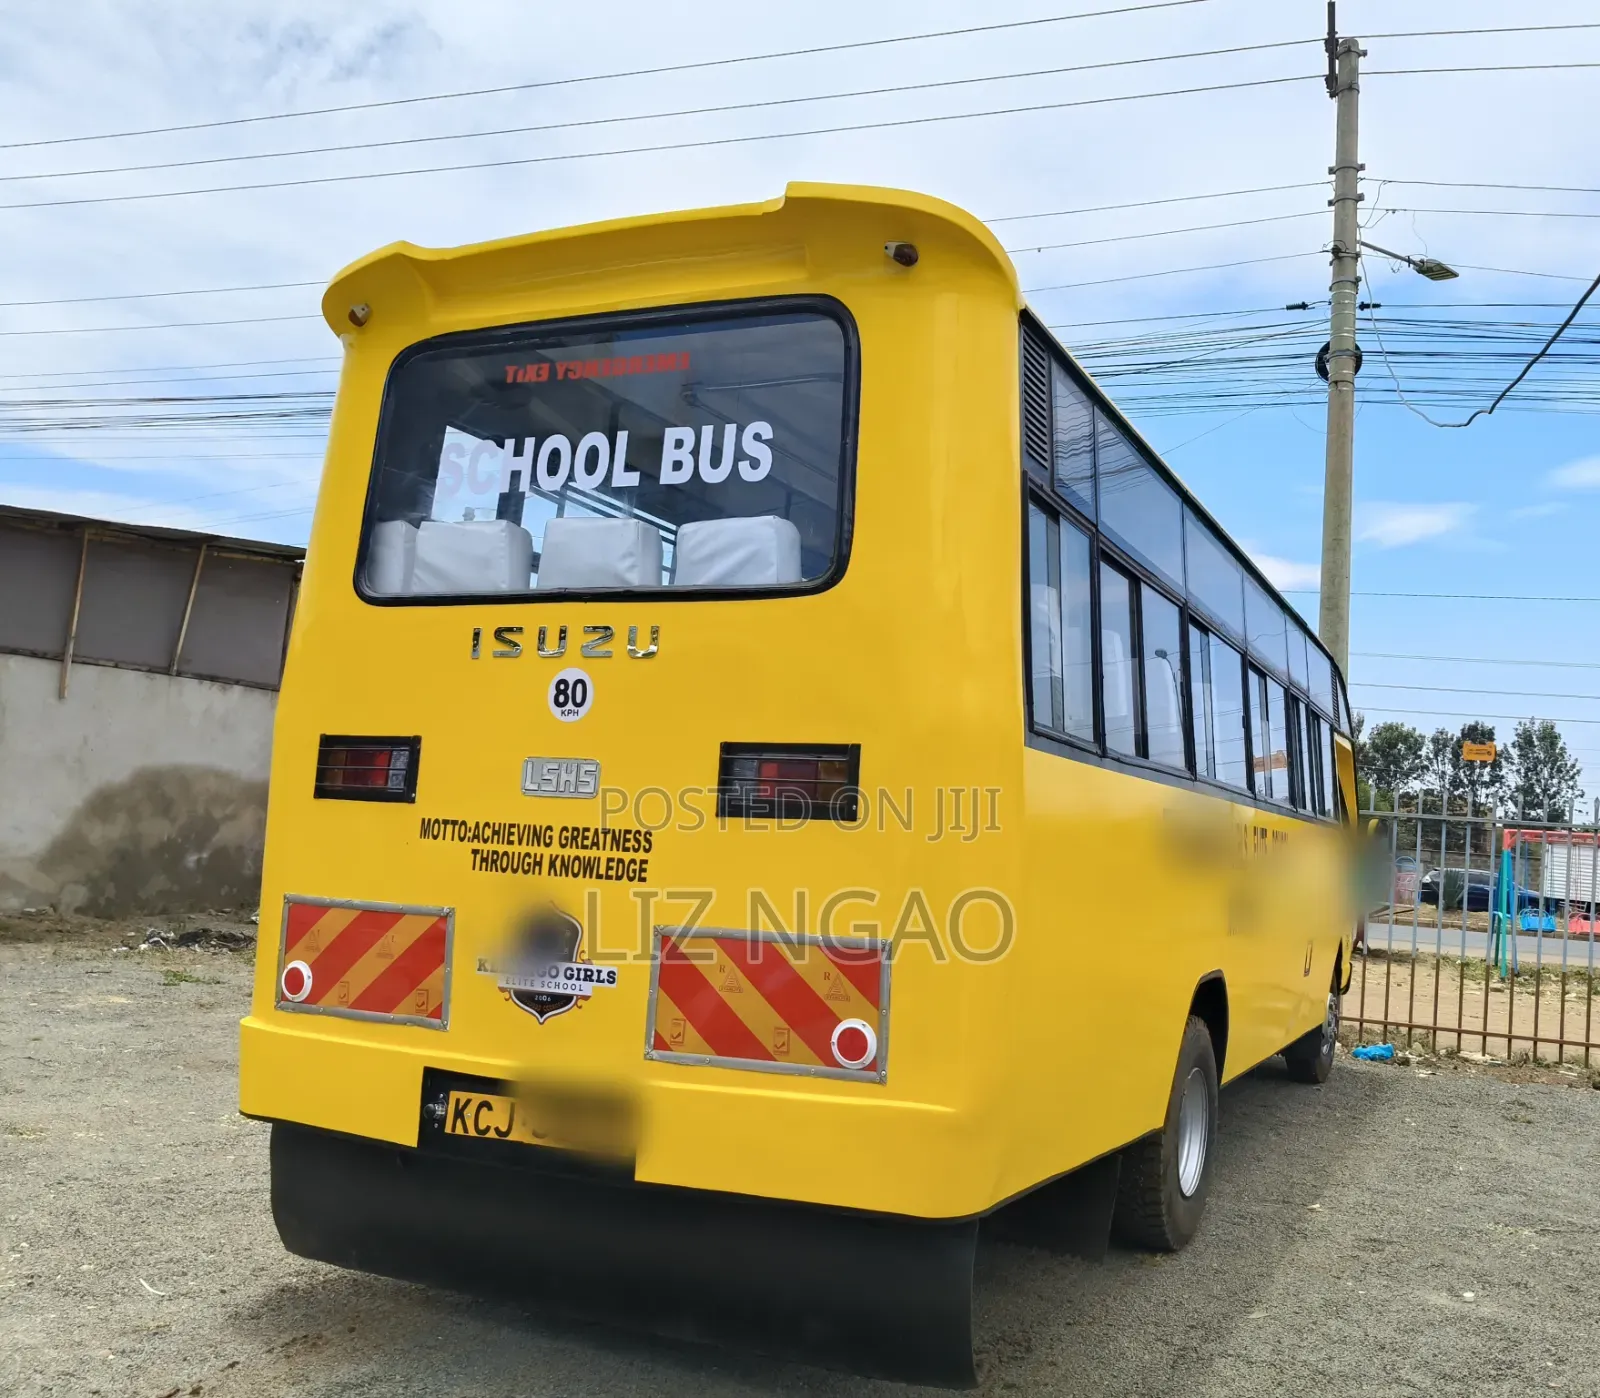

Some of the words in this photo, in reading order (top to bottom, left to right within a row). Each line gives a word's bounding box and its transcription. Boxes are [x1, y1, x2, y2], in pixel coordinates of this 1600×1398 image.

[441, 430, 640, 495] SCHOOL
[659, 421, 774, 485] BUS
[470, 625, 660, 660] ISUZU
[553, 678, 588, 708] 80
[560, 709, 579, 717] KPH
[524, 760, 598, 794] LSHS
[558, 826, 653, 854] GREATNESS
[471, 849, 544, 876] THROUGH
[547, 854, 649, 883] KNOWLEDGE
[505, 976, 535, 987] ELITE
[541, 981, 584, 992] SCHOOL
[563, 967, 617, 985] GIRLS
[451, 1097, 516, 1139] KCJ
